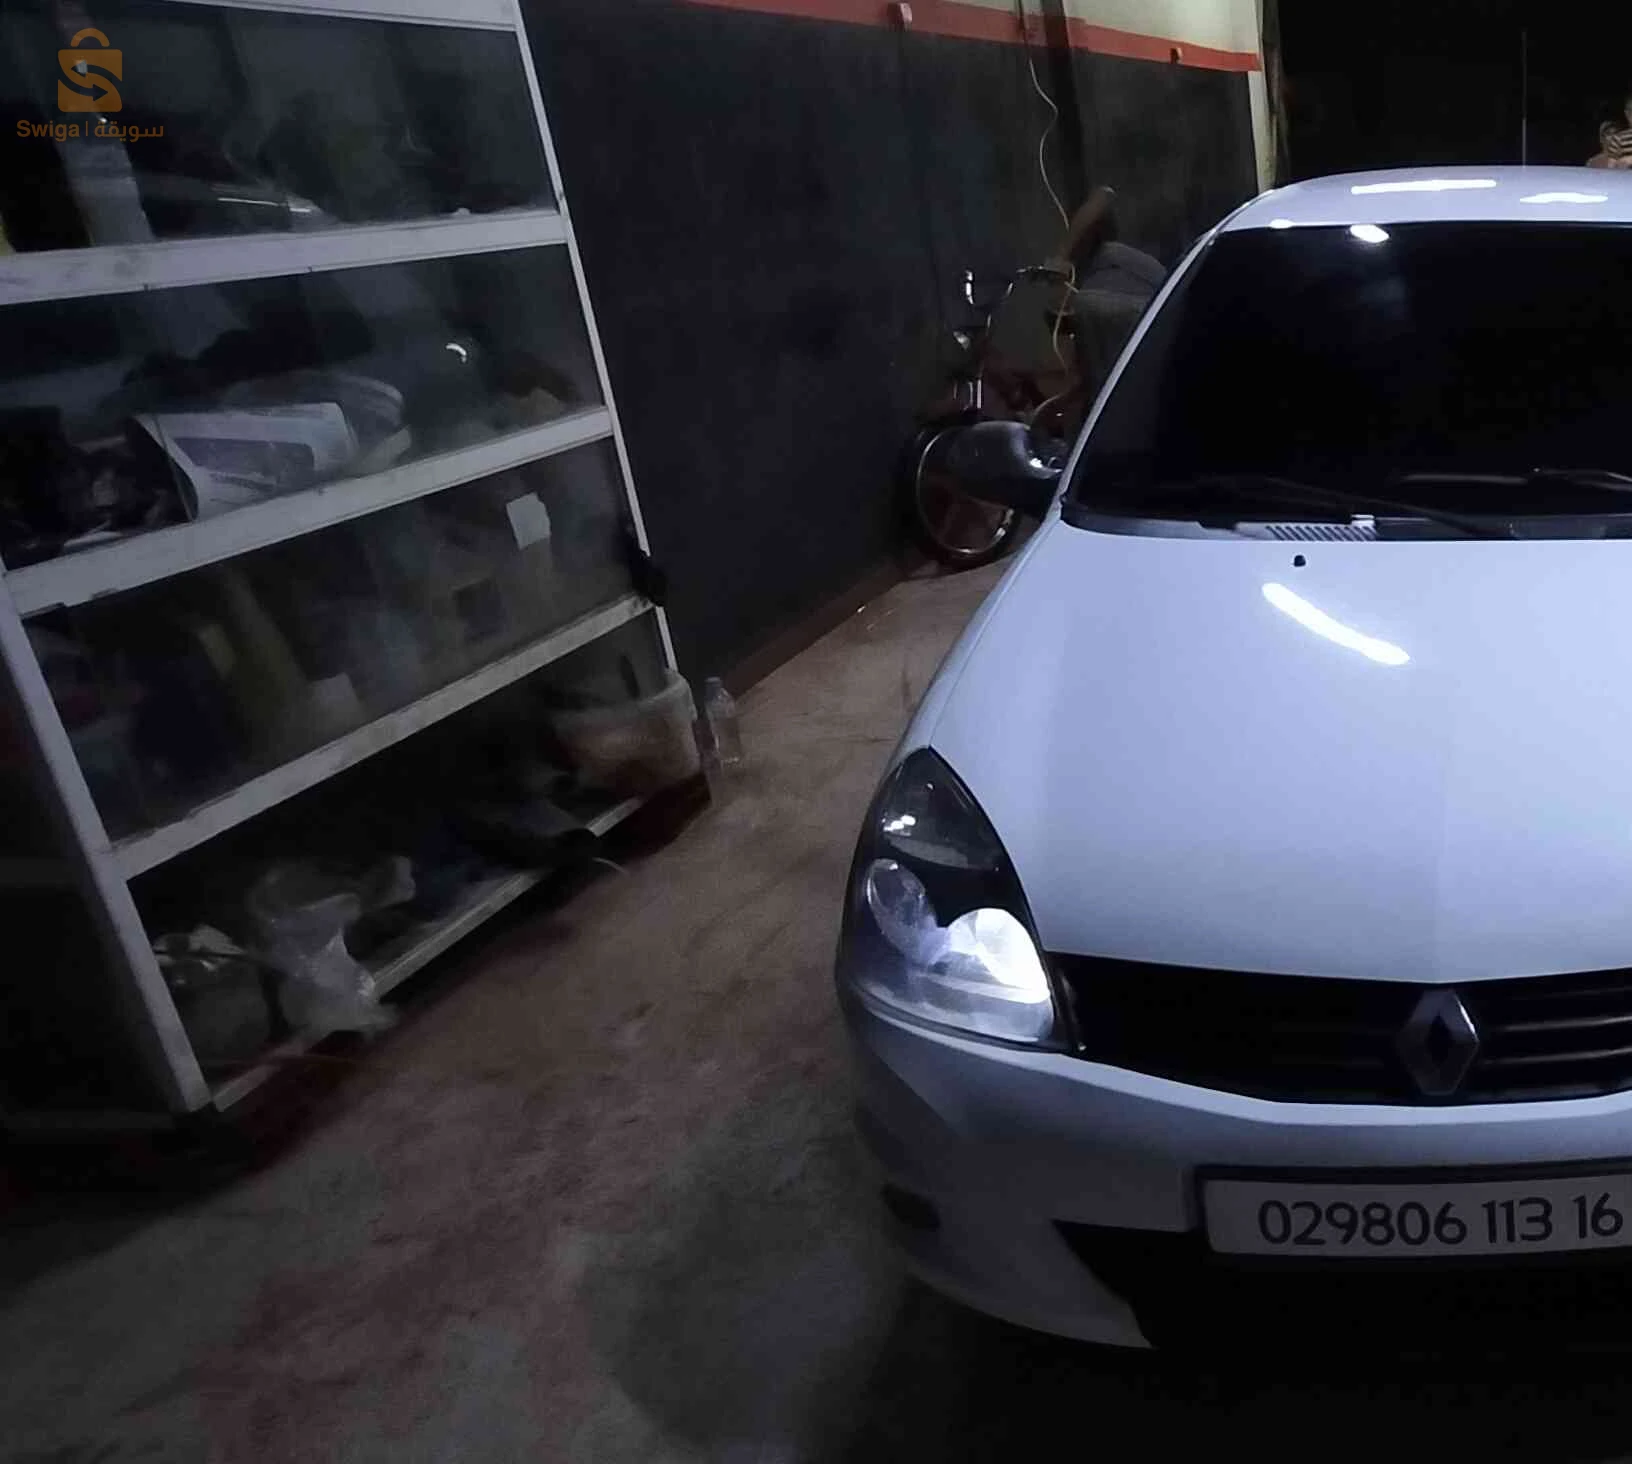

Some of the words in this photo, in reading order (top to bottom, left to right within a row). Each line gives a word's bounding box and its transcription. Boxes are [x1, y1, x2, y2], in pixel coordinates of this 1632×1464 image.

[1257, 1199, 1468, 1246] 029806
[1481, 1196, 1553, 1244] 113
[1572, 1191, 1624, 1239] 16
